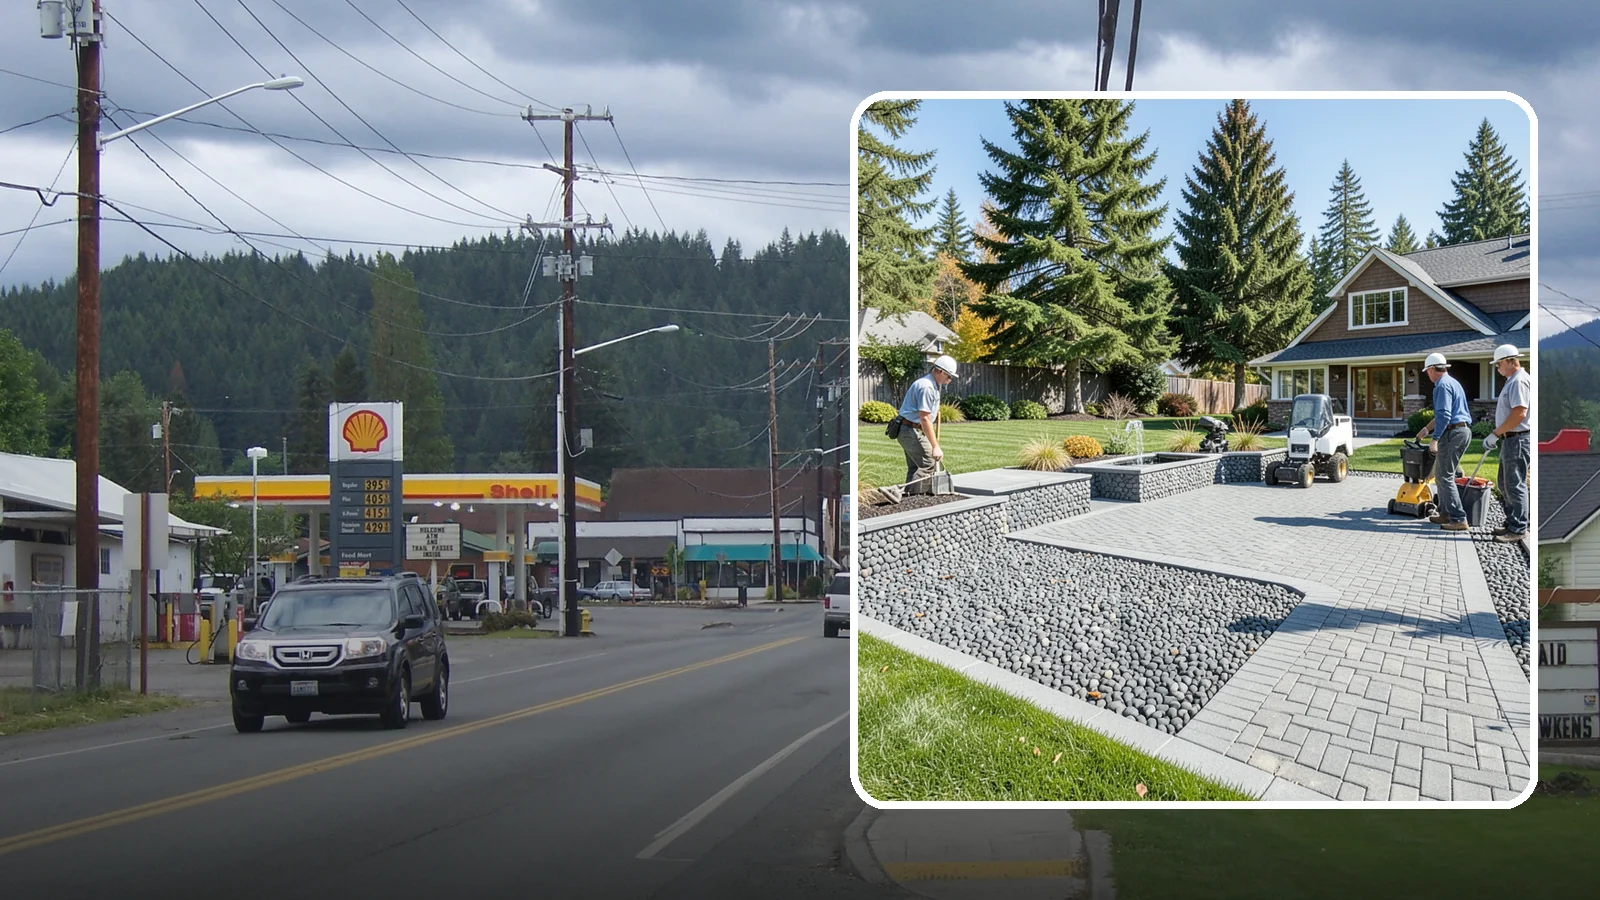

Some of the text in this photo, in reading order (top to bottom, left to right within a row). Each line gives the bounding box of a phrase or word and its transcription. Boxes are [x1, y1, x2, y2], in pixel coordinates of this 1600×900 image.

[365, 480, 384, 490] 395
[490, 484, 547, 499] Shell
[365, 494, 384, 504] 405
[365, 508, 384, 518] 415
[365, 522, 384, 532] 429
